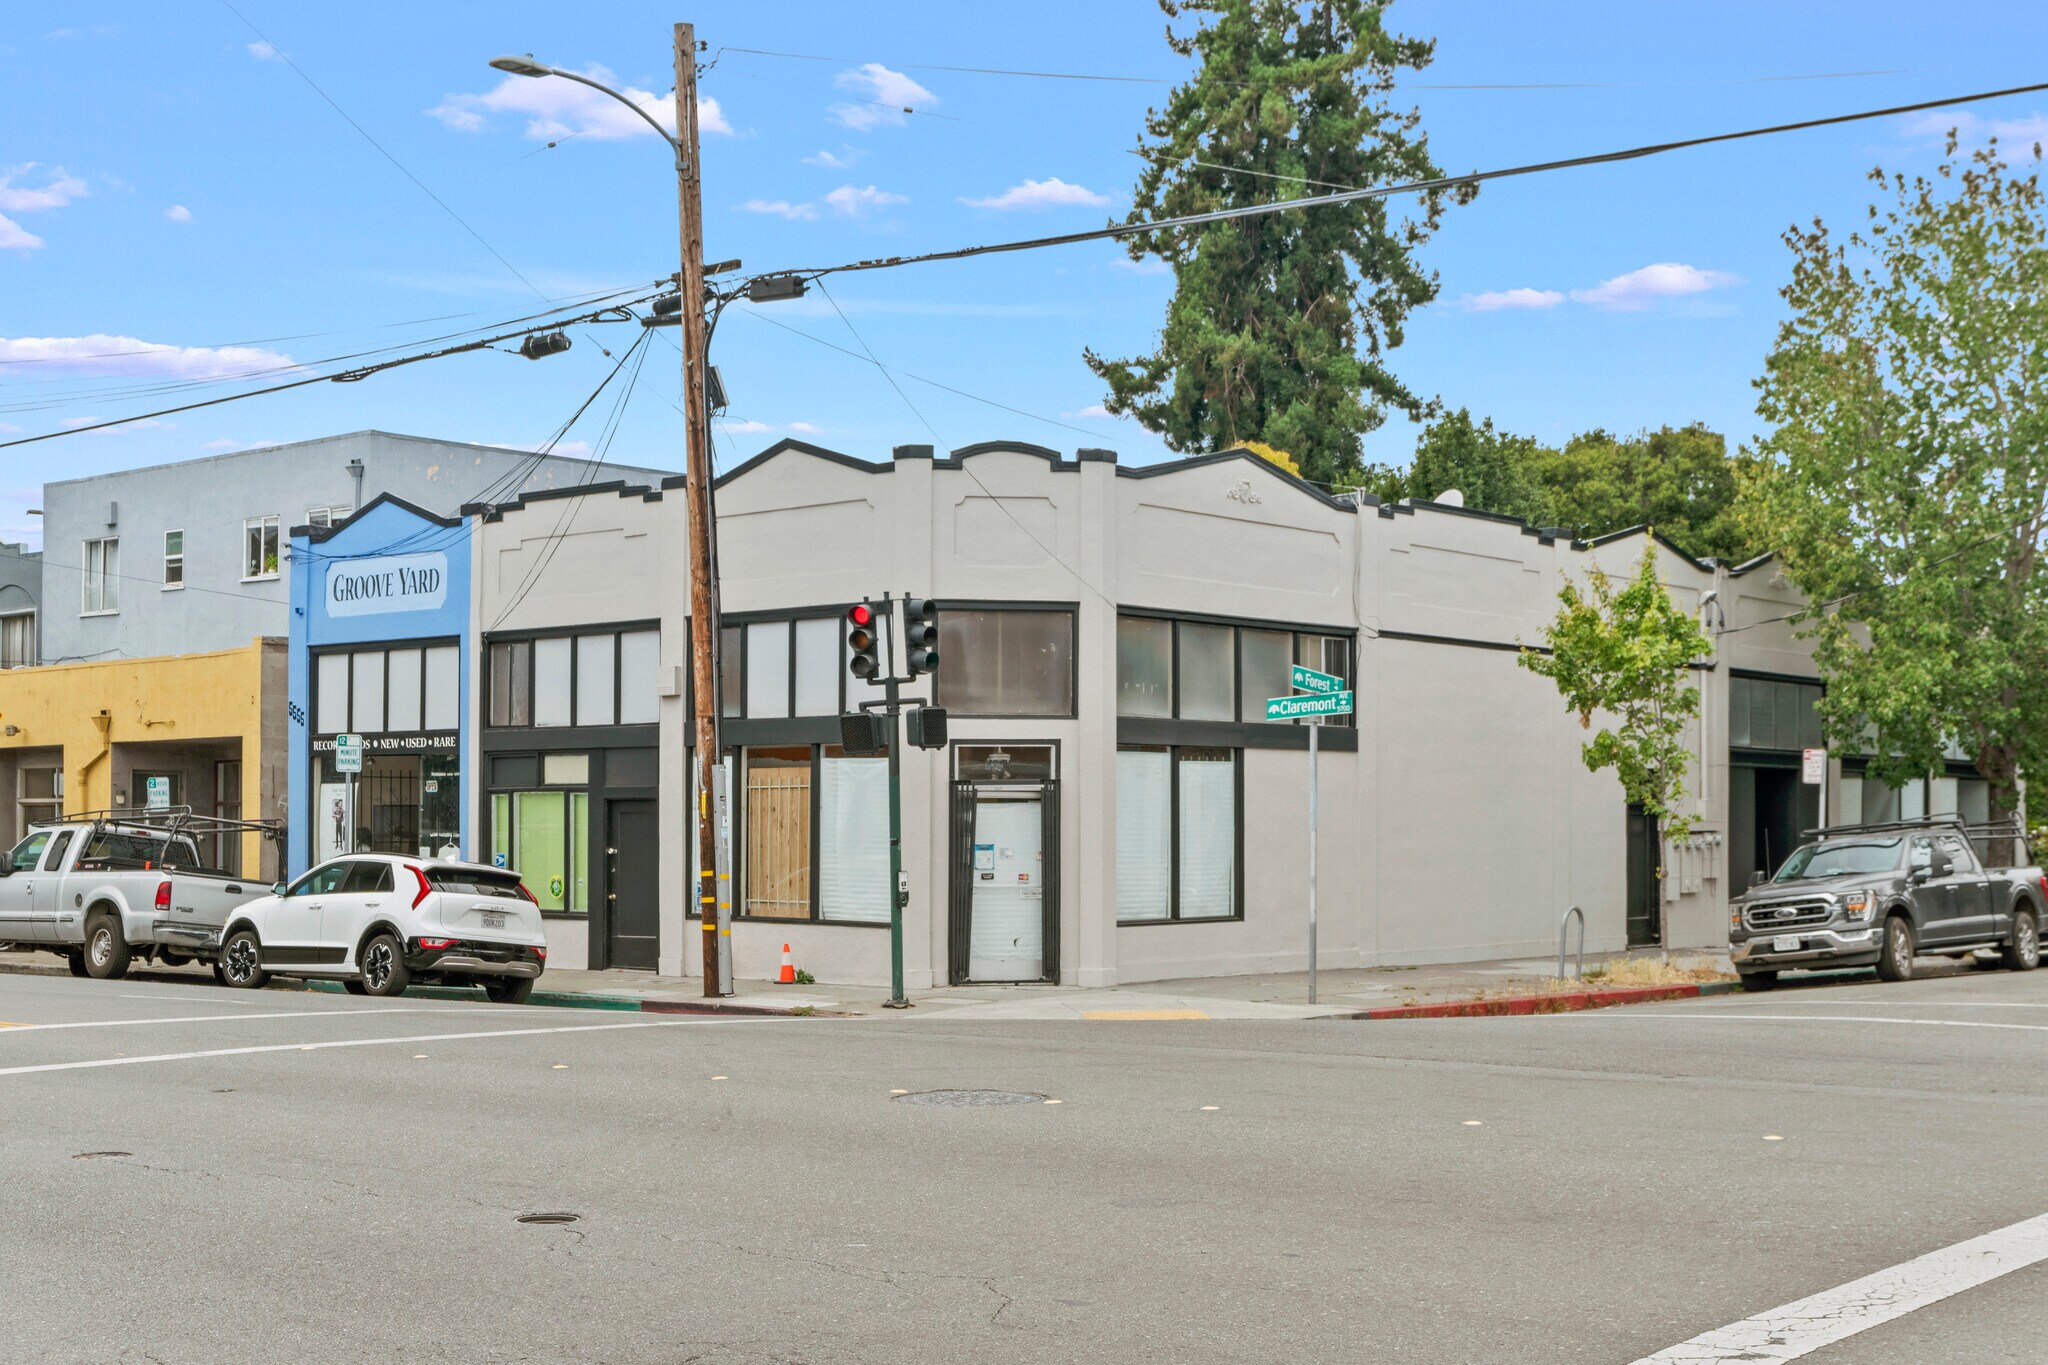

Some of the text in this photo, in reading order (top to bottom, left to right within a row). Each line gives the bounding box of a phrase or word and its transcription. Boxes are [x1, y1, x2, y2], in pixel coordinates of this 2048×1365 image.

[333, 567, 440, 602] GROOVE YARD
[1305, 673, 1331, 692] Forest
[288, 701, 305, 727] 5555
[1280, 697, 1337, 715] Claremont
[380, 738, 400, 749] NEW
[405, 737, 427, 748] USED
[433, 736, 456, 748] RARE
